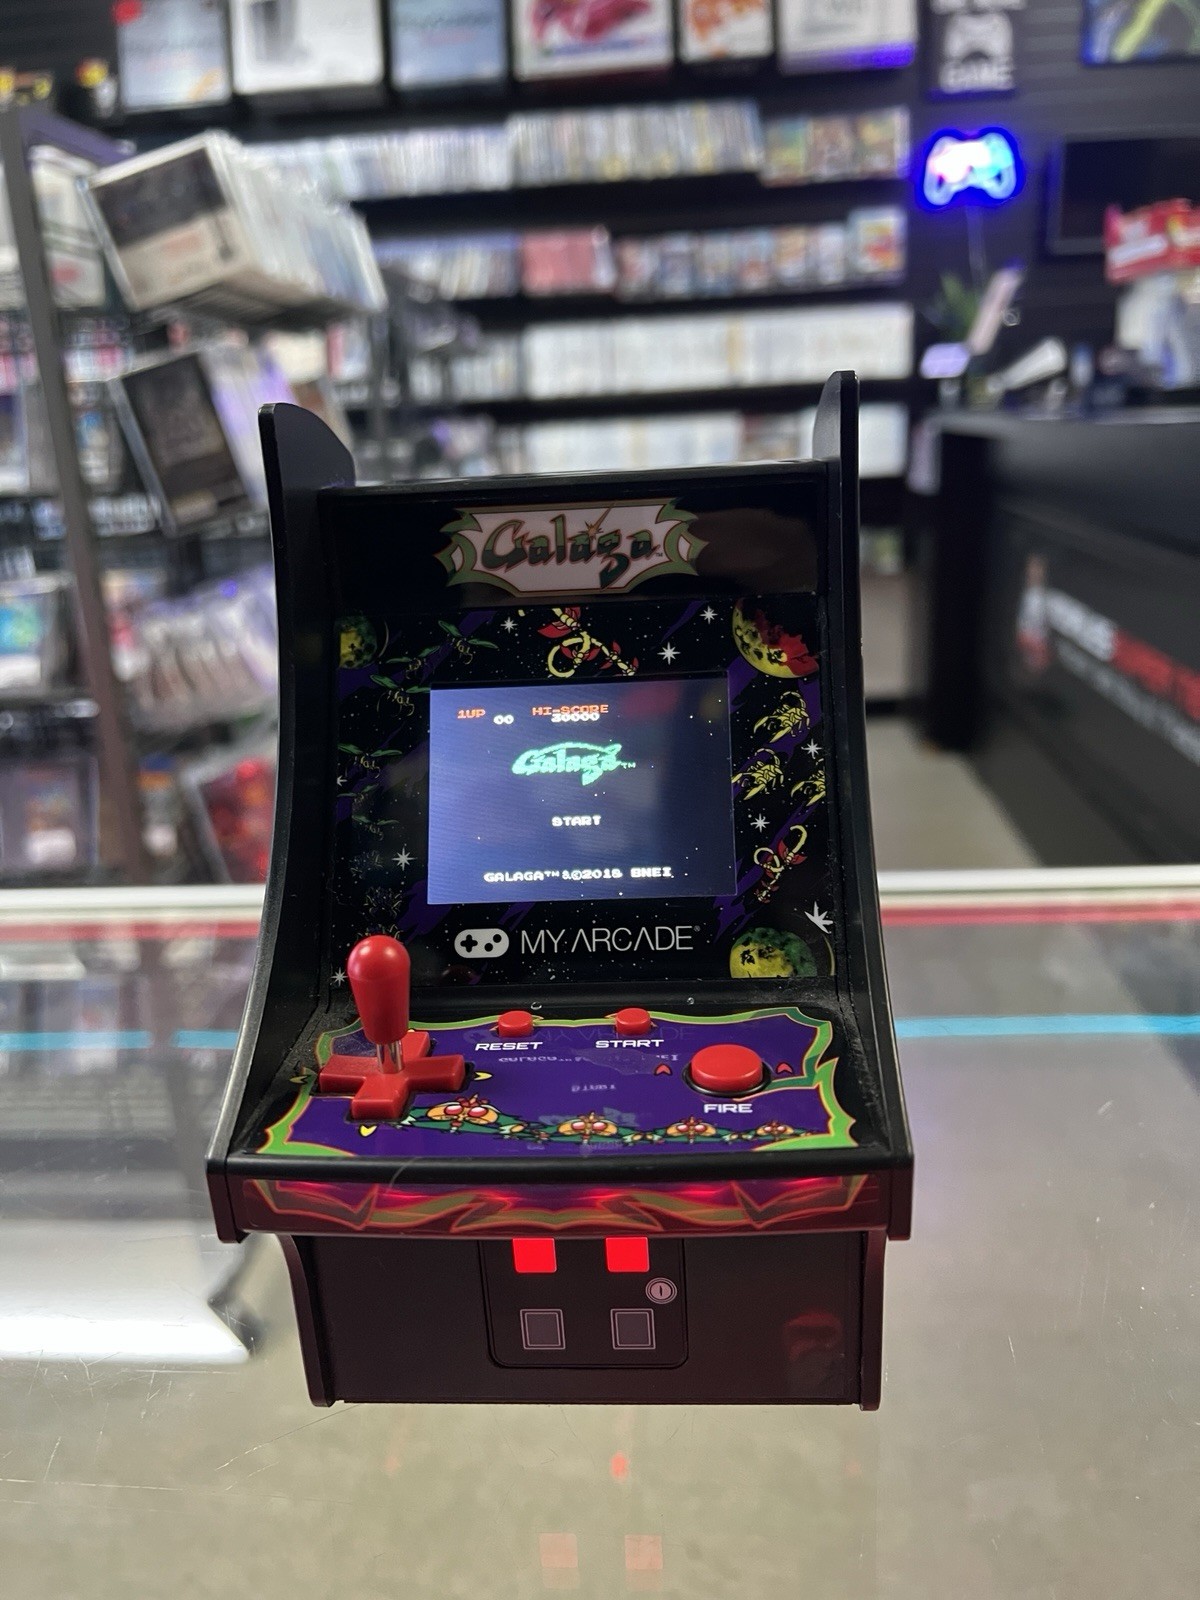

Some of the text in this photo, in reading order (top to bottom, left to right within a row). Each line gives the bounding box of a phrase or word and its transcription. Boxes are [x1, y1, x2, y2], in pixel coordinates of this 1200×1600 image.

[457, 709, 486, 719] 1UP
[532, 704, 609, 716] HI-SCORE
[493, 714, 514, 725] 00
[551, 815, 602, 827] START
[521, 929, 566, 954] MY
[475, 1041, 543, 1051] RESET
[595, 1039, 664, 1049] START
[703, 1103, 753, 1114] FIRE
